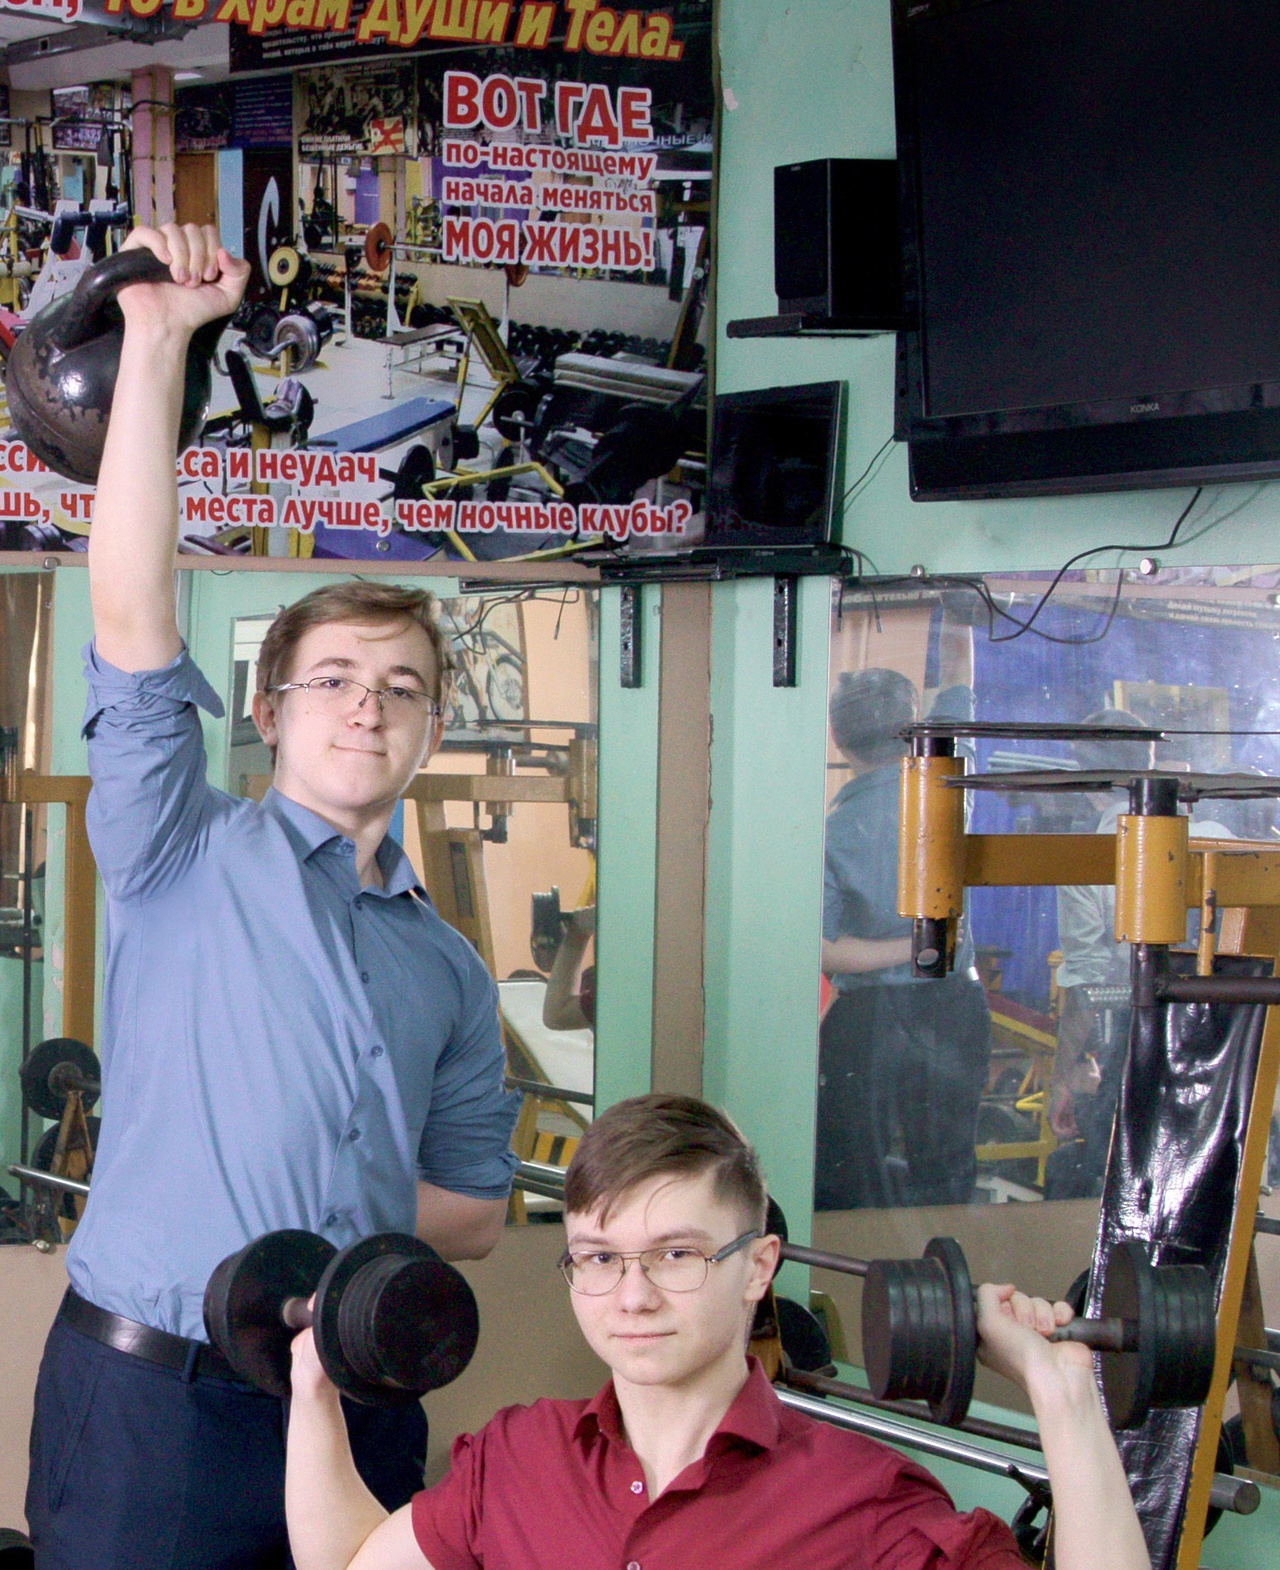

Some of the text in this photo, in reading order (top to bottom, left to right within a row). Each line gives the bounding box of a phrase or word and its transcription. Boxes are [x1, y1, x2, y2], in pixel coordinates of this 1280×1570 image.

[356, 0, 510, 43] Души
[517, 3, 554, 47] и
[566, 0, 683, 58] Тела.
[446, 75, 651, 146] ВОТ ГДЕ
[446, 143, 653, 181] по-настоящему
[446, 181, 653, 213] начала меняться
[446, 220, 652, 268] МОЯ ЖИЗНЬ!
[1130, 402, 1160, 414] KONKA
[228, 451, 250, 479] и
[260, 452, 376, 487] неудач
[60, 493, 95, 518] чт
[185, 497, 274, 524] места
[282, 500, 390, 533] лучше,
[398, 504, 452, 529] чем
[460, 505, 569, 531] ночные
[581, 503, 691, 537] клубы?
